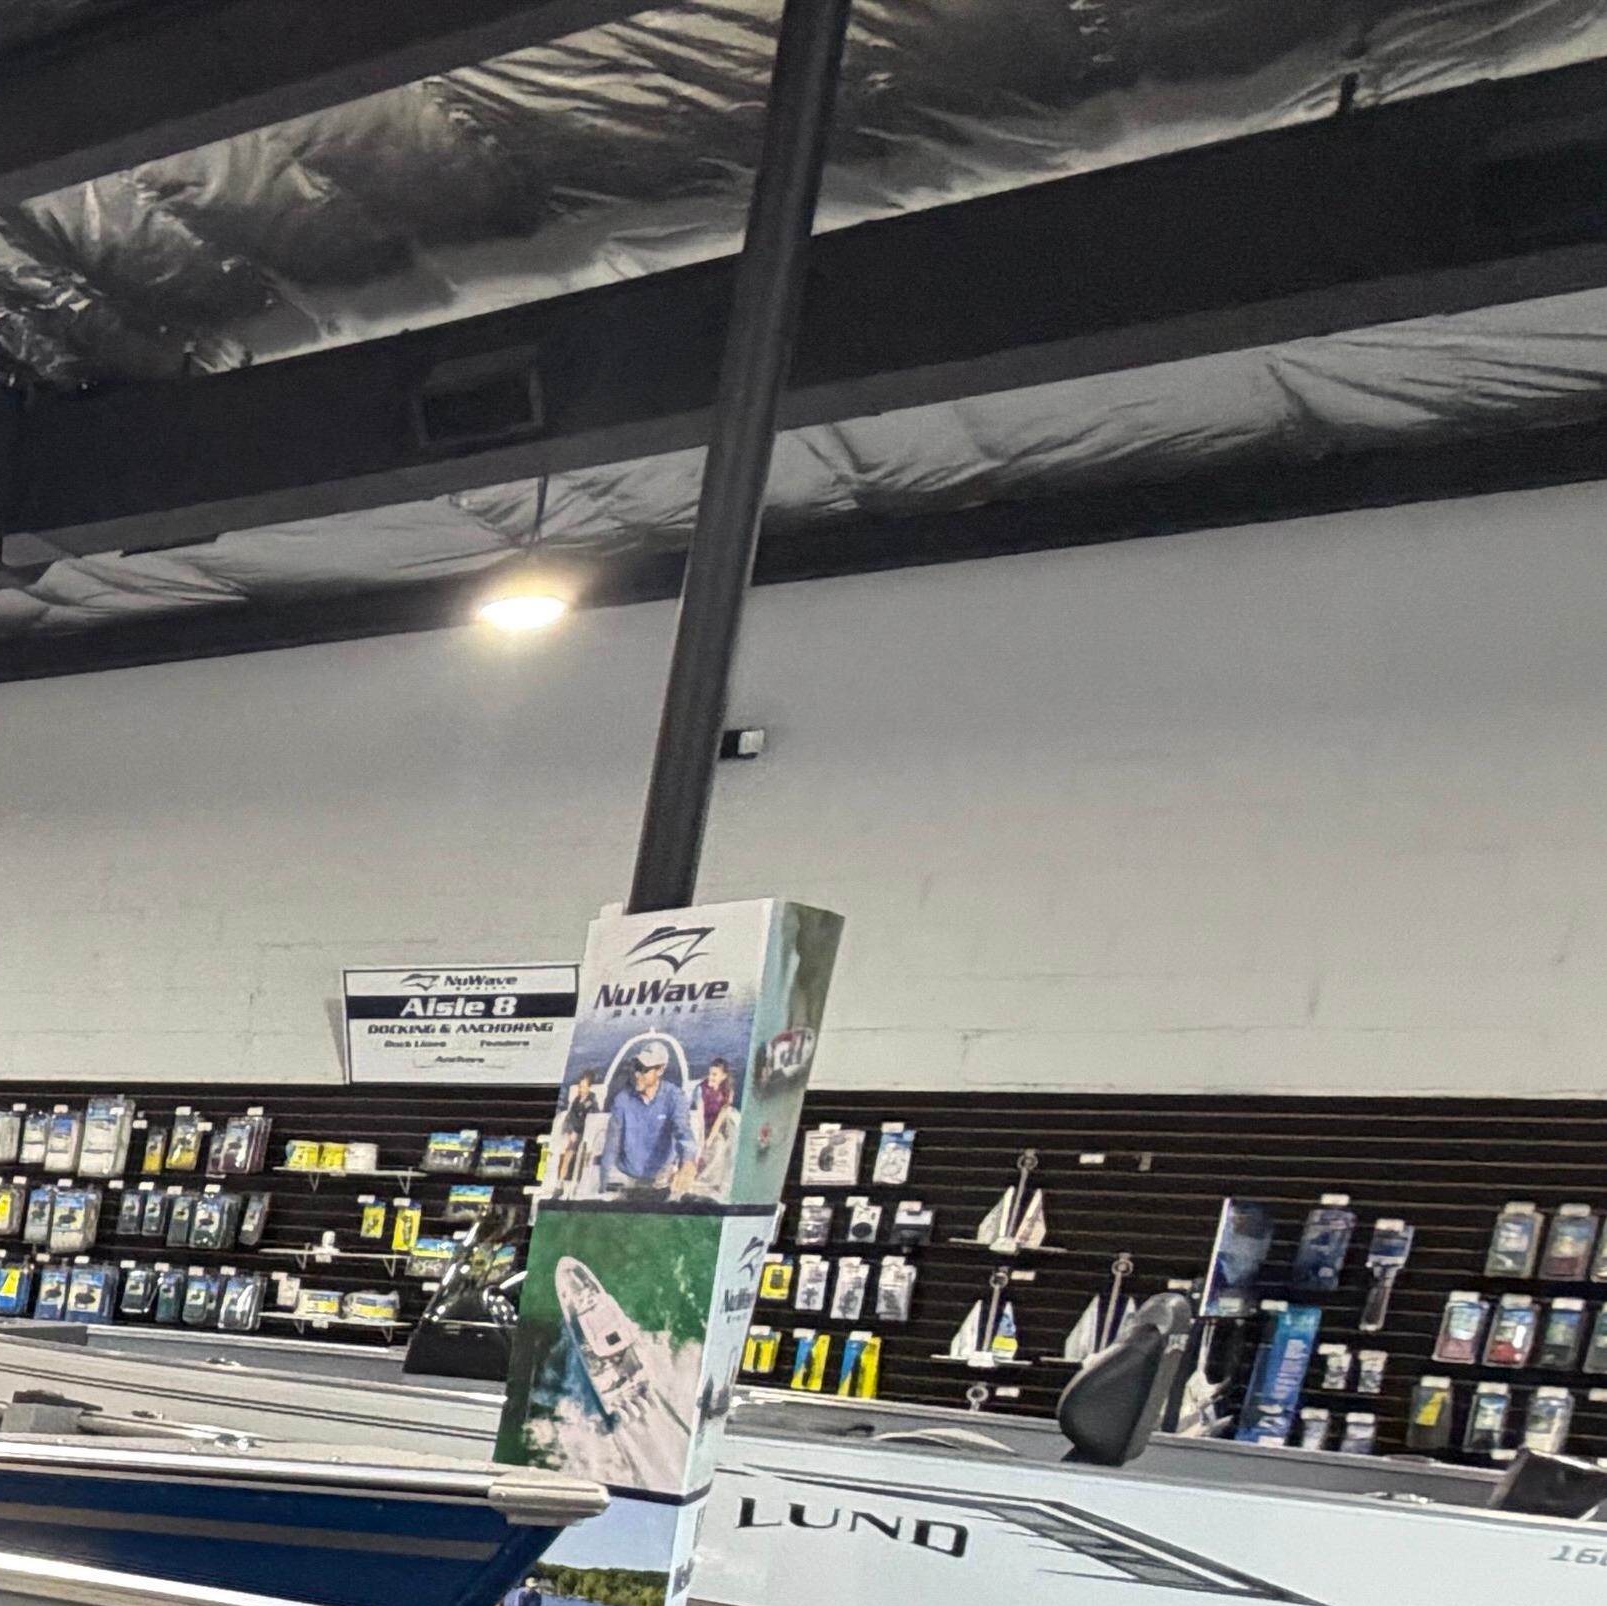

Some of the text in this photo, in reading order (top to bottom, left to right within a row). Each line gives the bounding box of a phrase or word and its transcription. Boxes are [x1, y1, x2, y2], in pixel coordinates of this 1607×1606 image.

[444, 975, 518, 987] NuWave
[594, 978, 729, 1009] NuWave
[400, 996, 518, 1017] Aisle 8
[368, 1024, 436, 1035] DOCKING
[455, 1022, 554, 1034] ANCHORING
[734, 1496, 969, 1558] LUND
